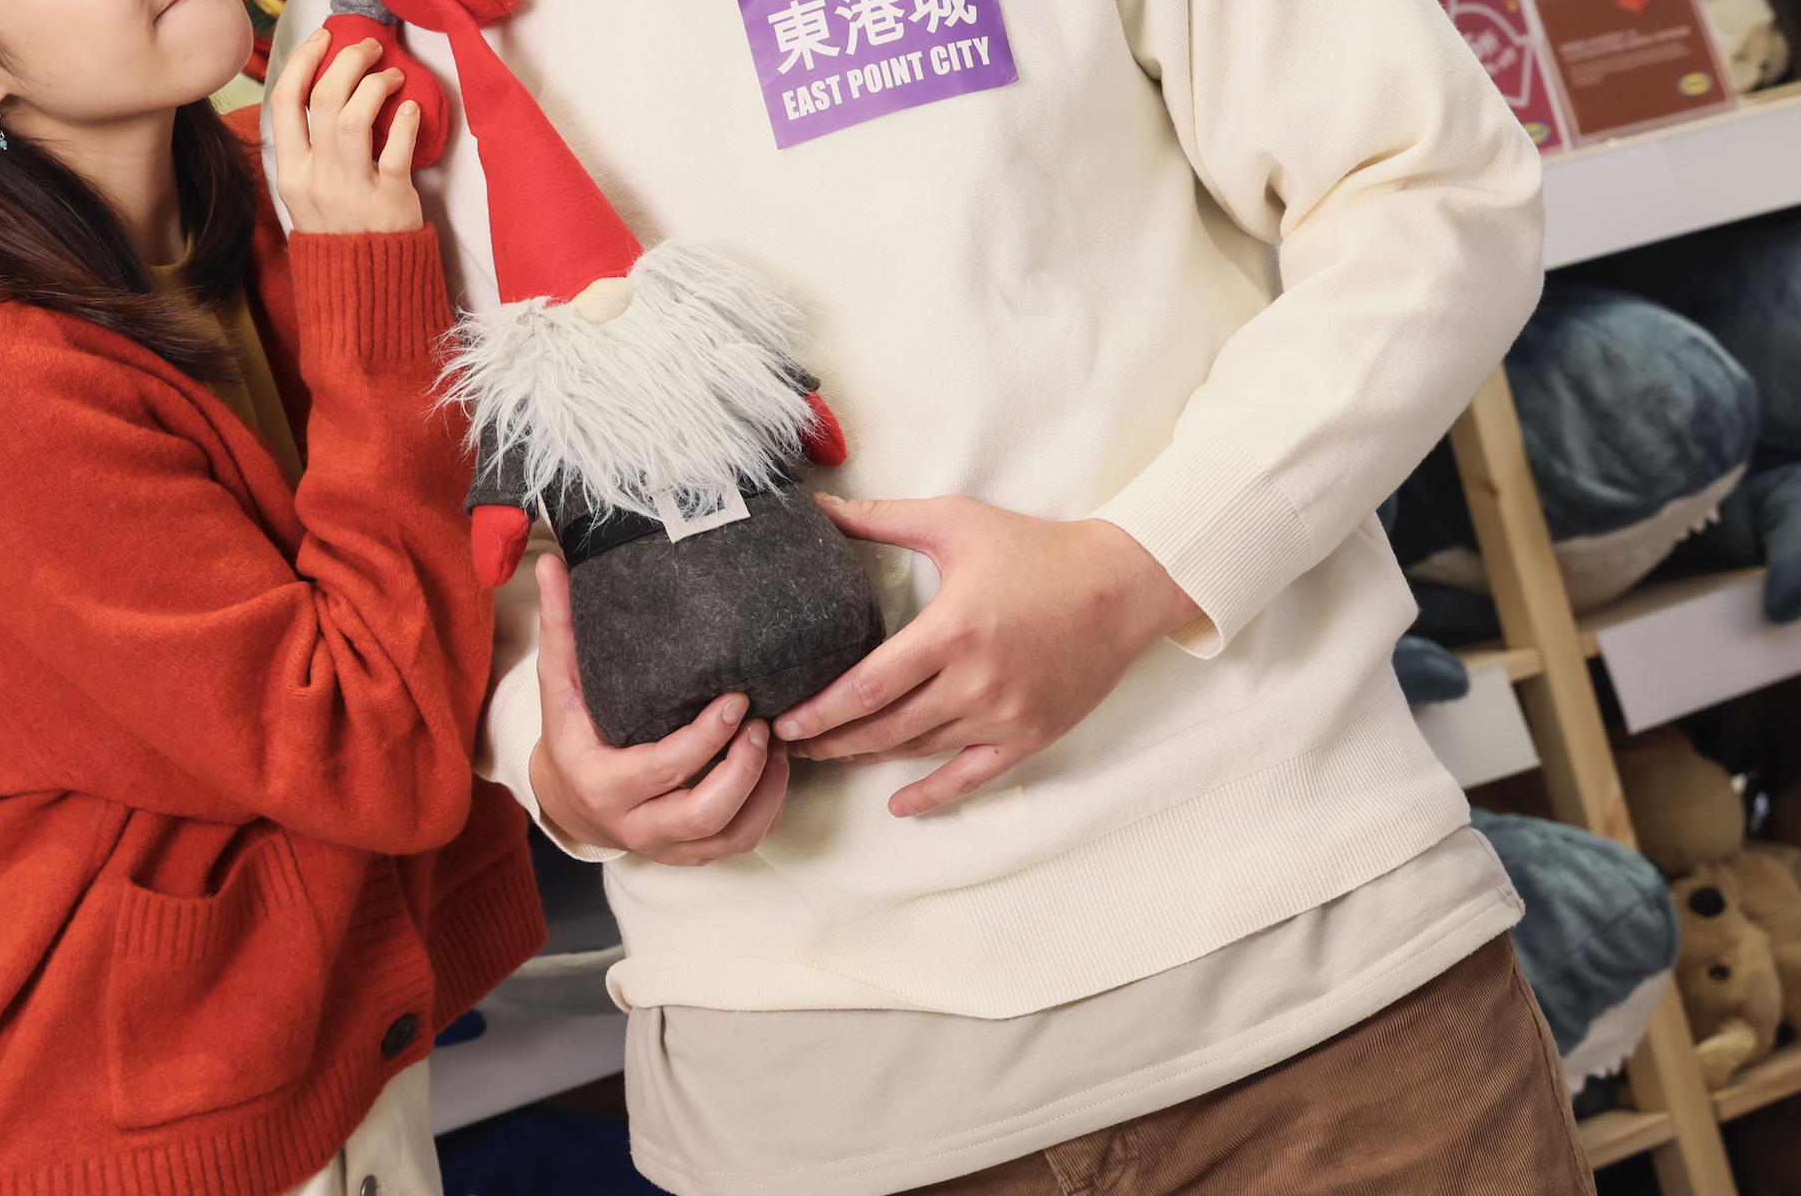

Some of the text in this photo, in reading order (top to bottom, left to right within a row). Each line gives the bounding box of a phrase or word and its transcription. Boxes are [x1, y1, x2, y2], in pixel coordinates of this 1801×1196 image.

[782, 36, 991, 121] EAST POINT CITY
